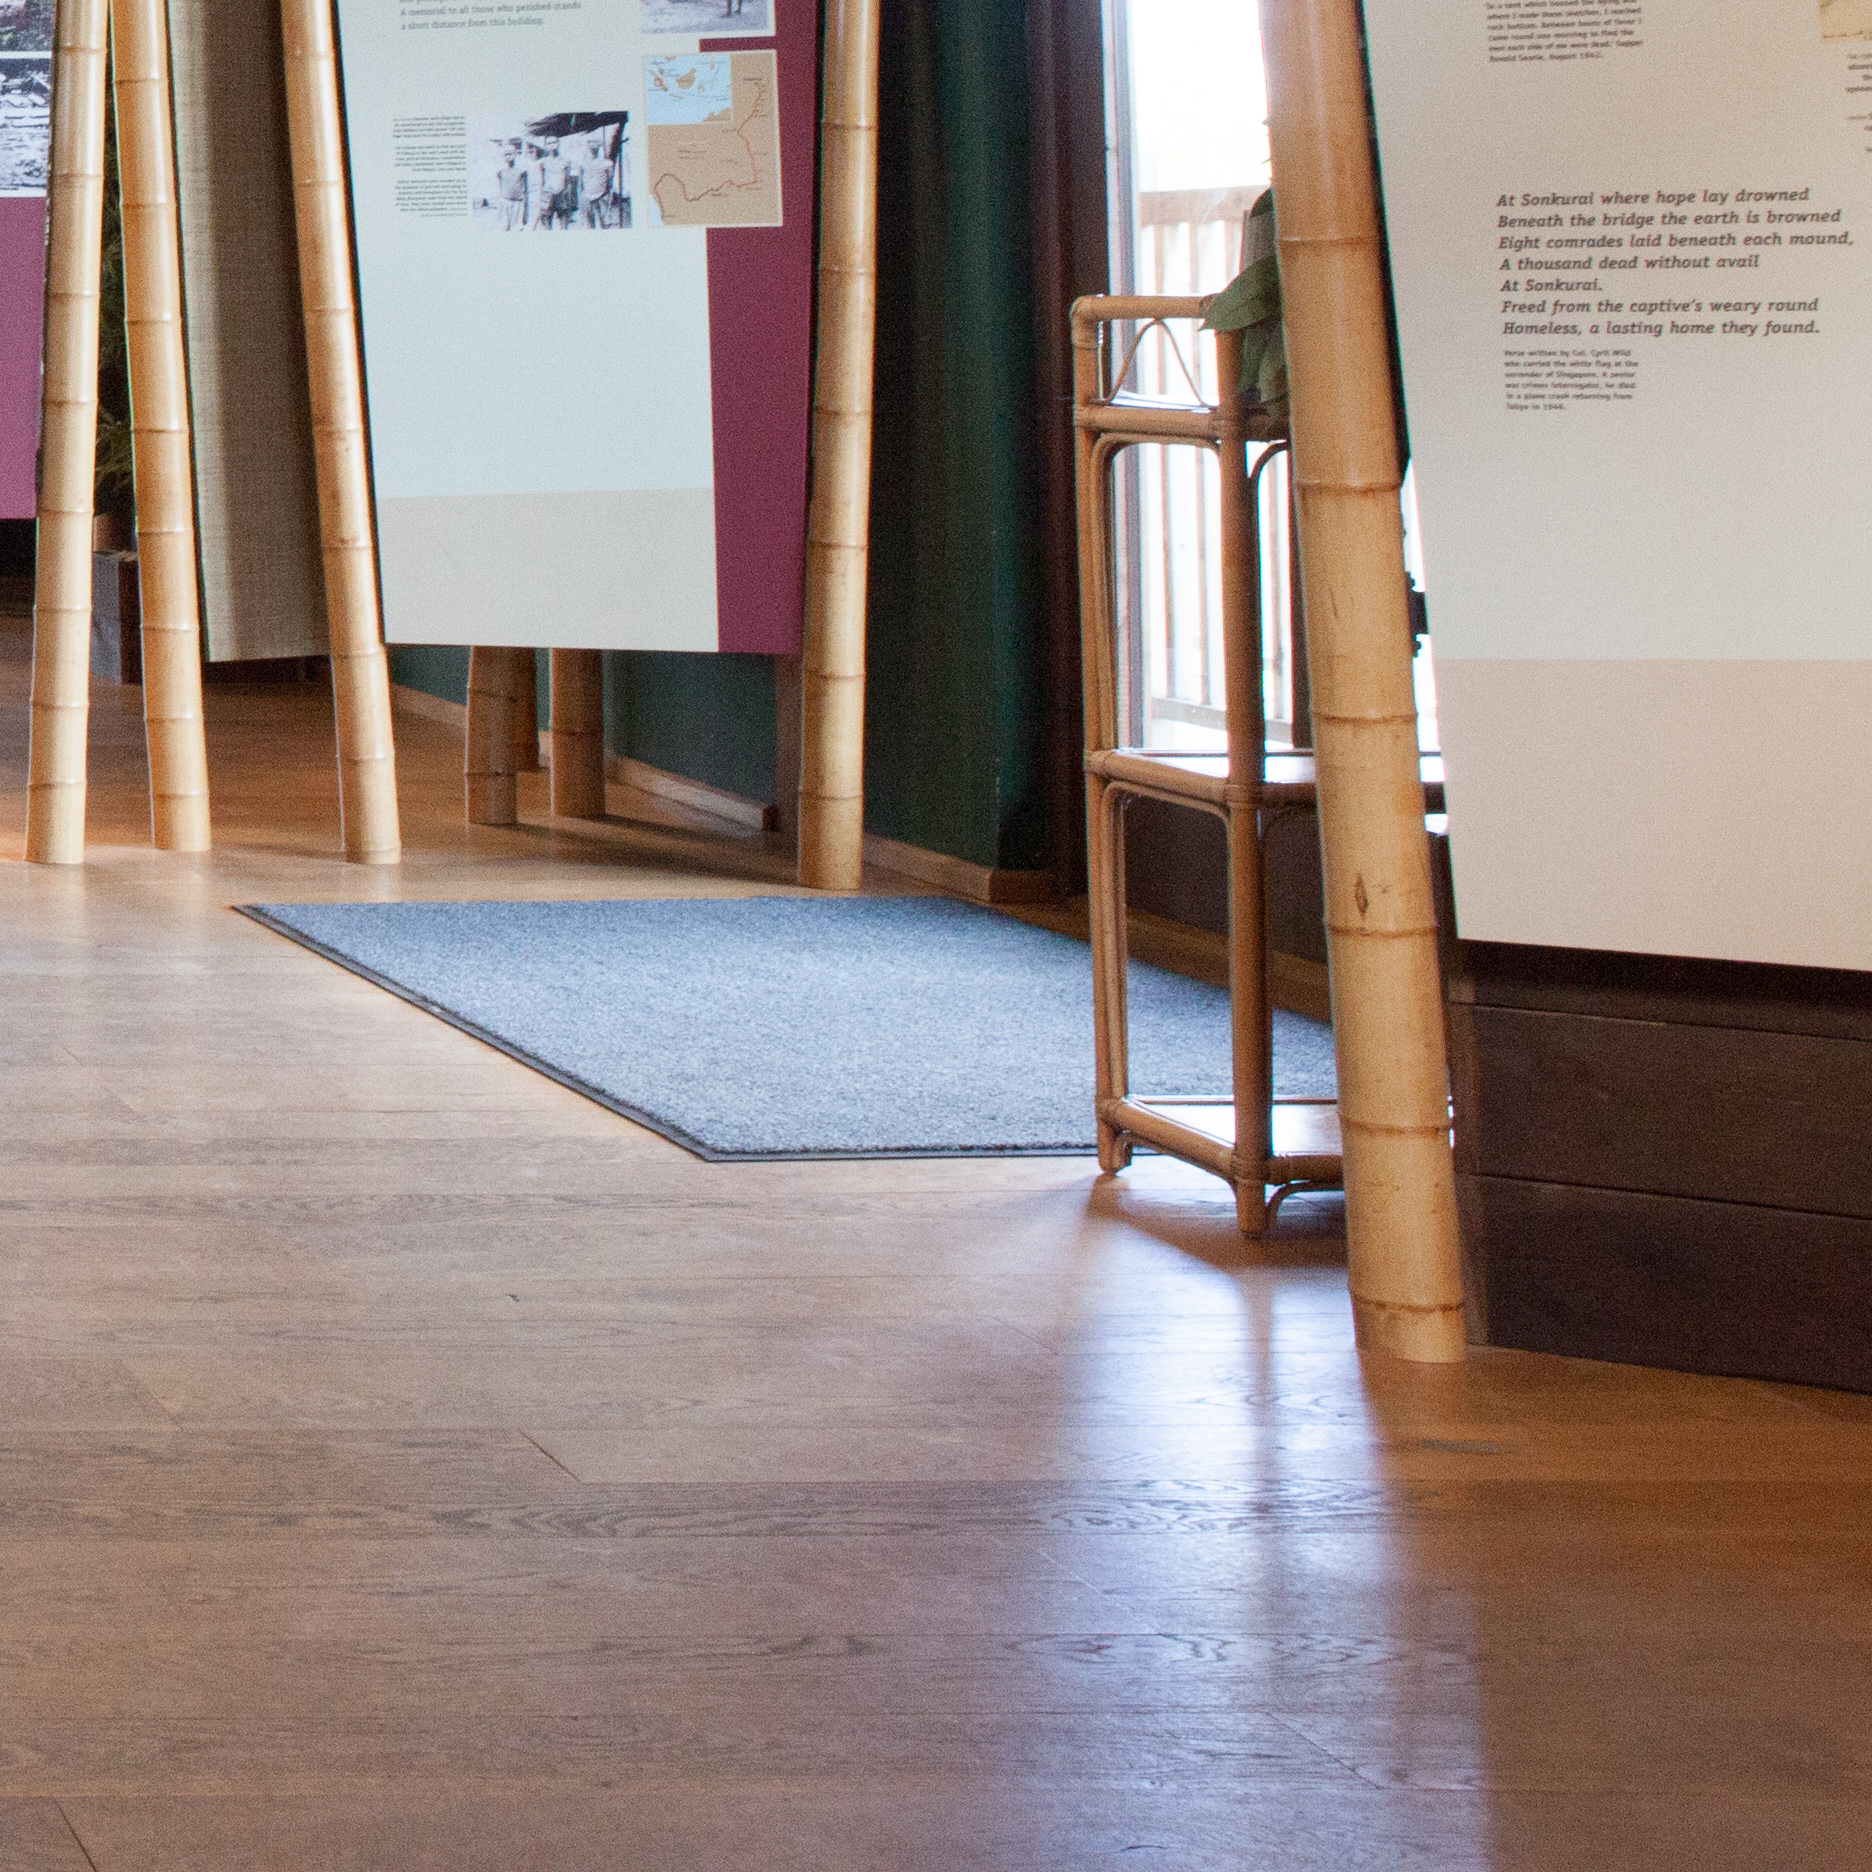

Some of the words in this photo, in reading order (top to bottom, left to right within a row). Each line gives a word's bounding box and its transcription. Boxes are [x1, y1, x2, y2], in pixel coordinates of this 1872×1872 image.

[1496, 193, 1516, 208] At
[1520, 191, 1595, 207] Sonkurai
[1600, 190, 1651, 205] where
[1655, 190, 1697, 207] hope
[1702, 189, 1729, 206] lay
[1734, 187, 1810, 203] drowned
[1497, 213, 1564, 229] Beneath
[1569, 213, 1597, 227] the
[1601, 212, 1655, 230] bridge
[1660, 211, 1688, 226] the
[1693, 210, 1740, 226] earth
[1745, 210, 1760, 225] is
[1766, 208, 1843, 224] browned
[1498, 235, 1541, 253] Eight
[1545, 234, 1624, 249] comrades
[1629, 233, 1663, 248] laid
[1667, 232, 1737, 248] beneath
[1742, 231, 1783, 247] each
[1788, 230, 1854, 246] mound,
[1499, 257, 1512, 271] A
[1517, 256, 1594, 271] thousand
[1598, 255, 1639, 270] dead
[1644, 255, 1711, 270] without
[1715, 254, 1760, 269] avail
[1500, 279, 1520, 293] At
[1525, 277, 1602, 293] Sonkurai.
[1501, 299, 1548, 314] Freed
[1551, 299, 1592, 317] from
[1596, 298, 1624, 313] the
[1709, 301, 1762, 316] weary
[1767, 297, 1820, 313] round
[1502, 320, 1582, 336] Homeless,
[1588, 323, 1600, 335] a
[1605, 320, 1664, 338] lasting
[1669, 320, 1716, 335] home
[1720, 319, 1759, 337] they
[1763, 319, 1819, 337] found.
